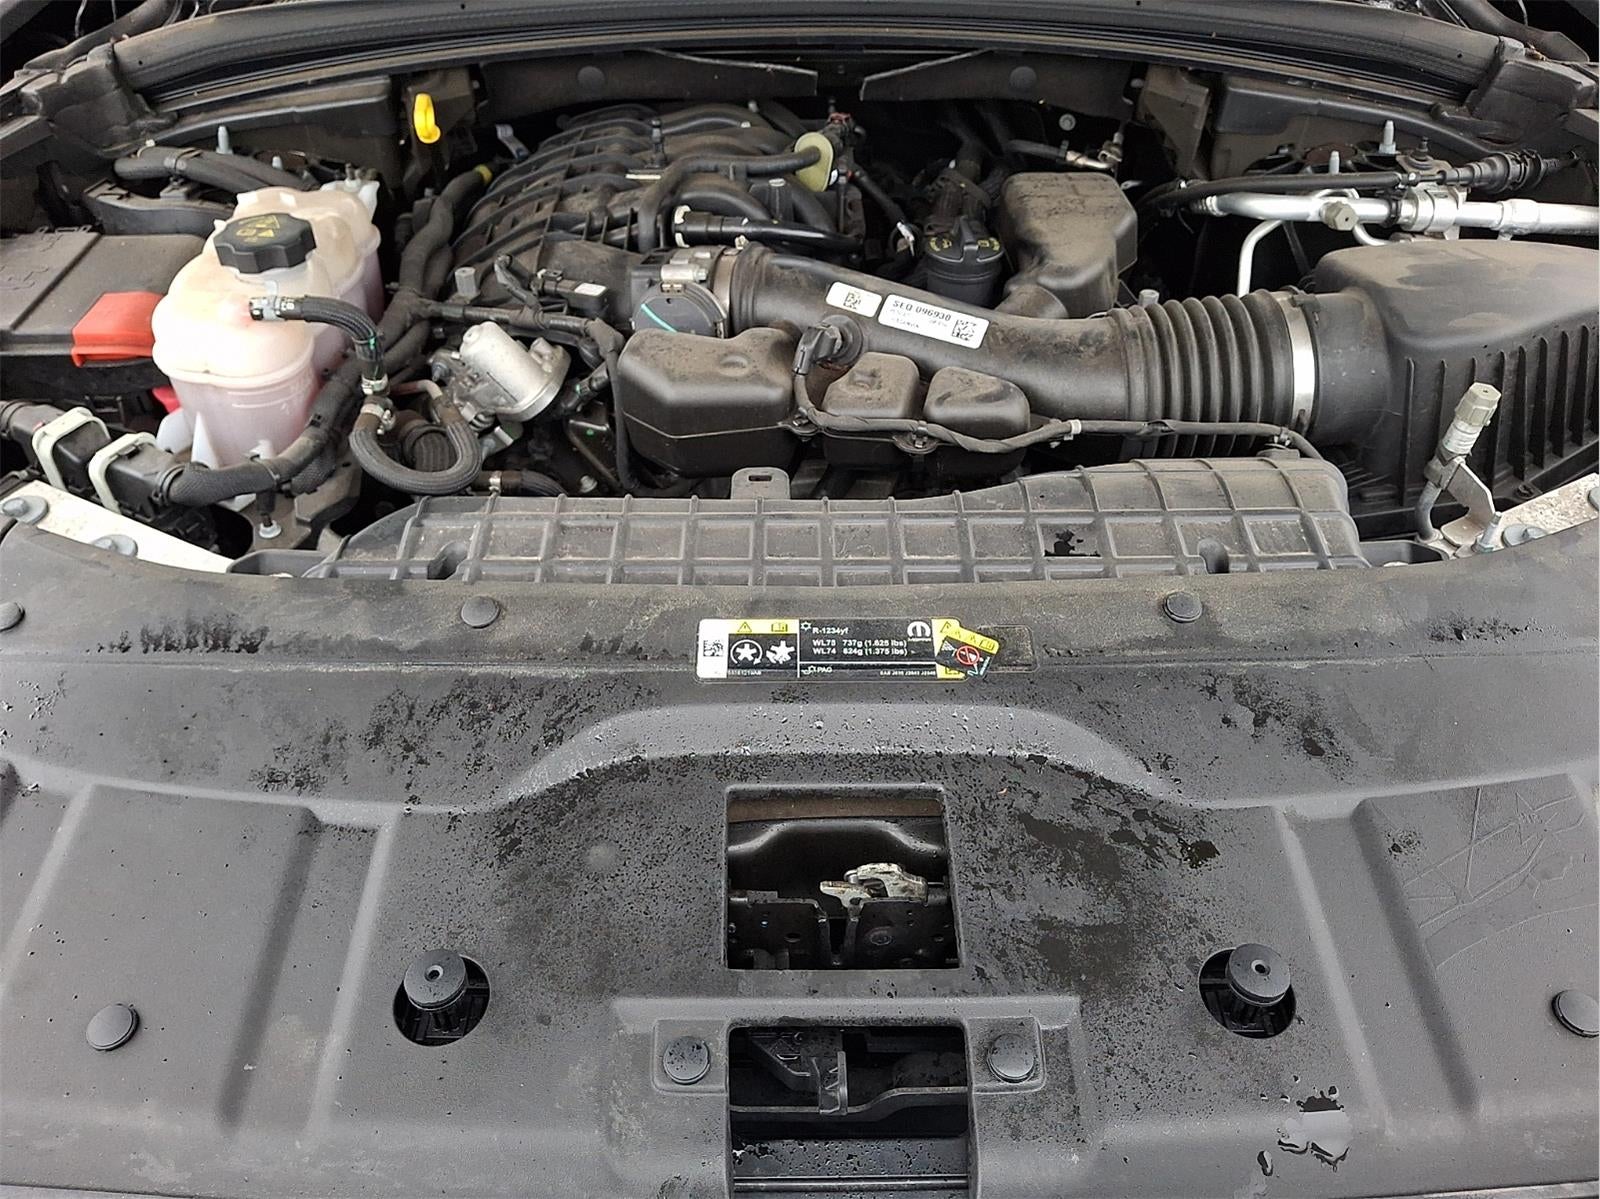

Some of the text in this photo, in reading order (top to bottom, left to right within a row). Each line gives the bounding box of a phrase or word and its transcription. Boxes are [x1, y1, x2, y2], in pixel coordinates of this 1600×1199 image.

[915, 306, 952, 321] 096930
[812, 627, 849, 635] R-1234yf
[842, 639, 863, 648] 737g
[890, 639, 908, 648] lbs)
[864, 648, 890, 656] (1.375
[891, 648, 908, 656] lbs)
